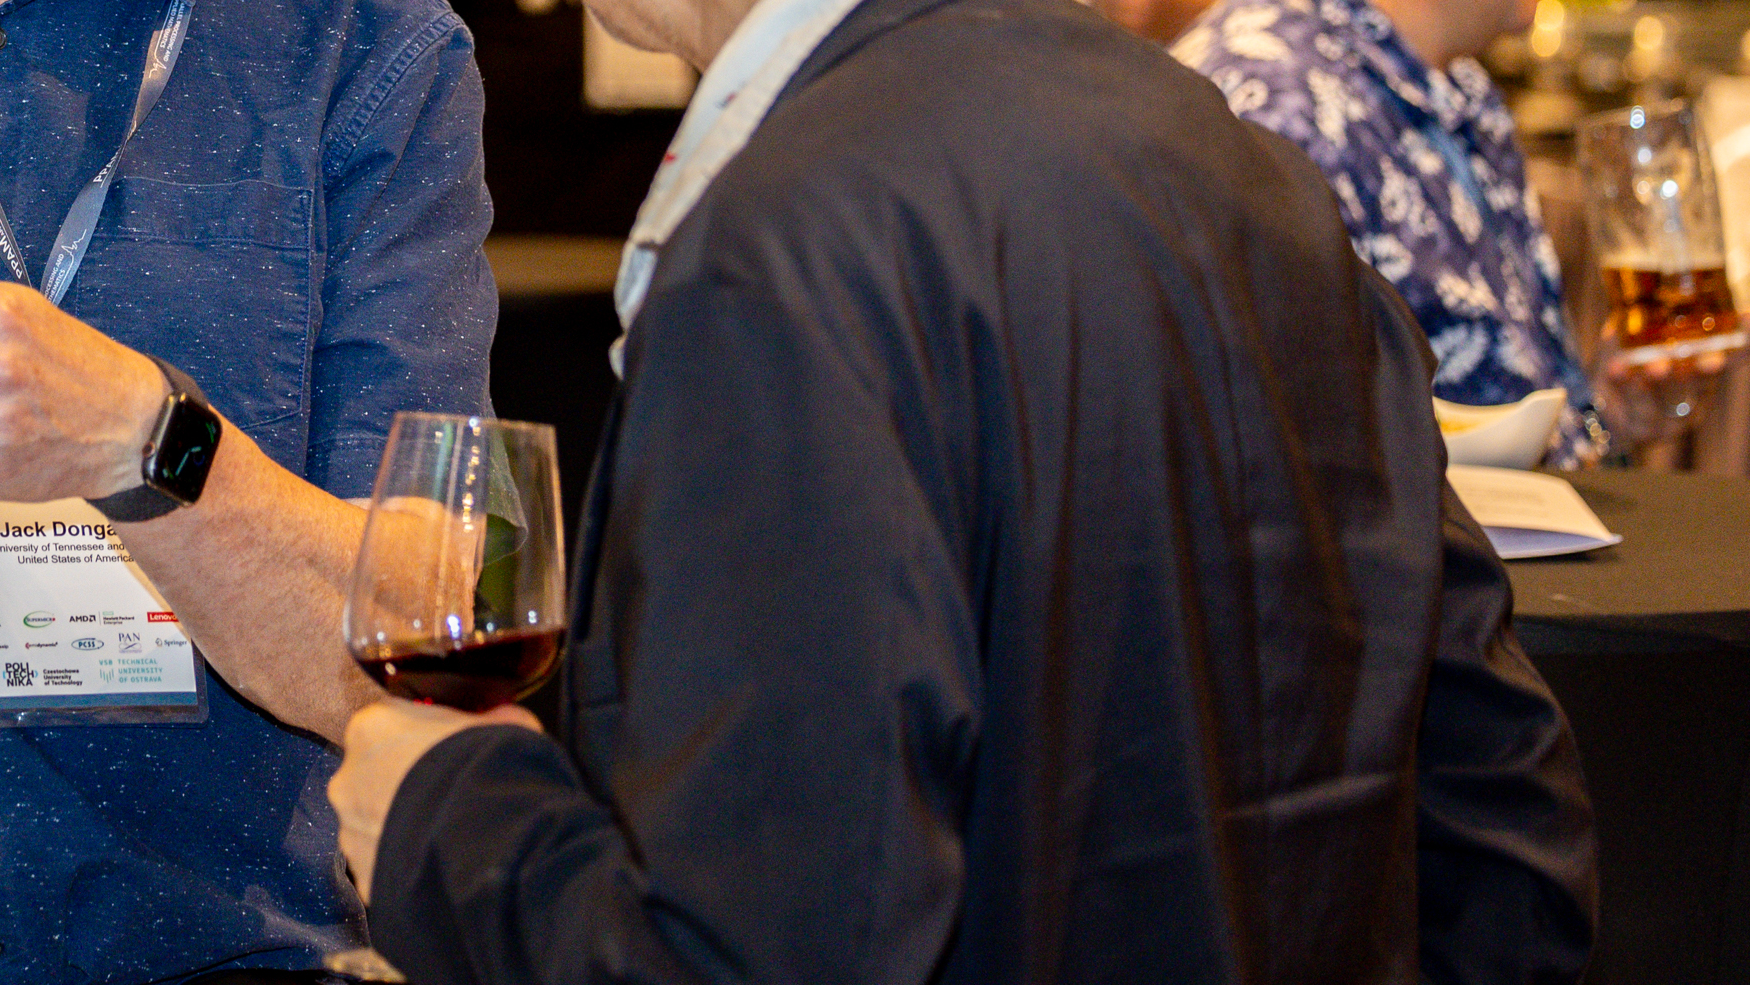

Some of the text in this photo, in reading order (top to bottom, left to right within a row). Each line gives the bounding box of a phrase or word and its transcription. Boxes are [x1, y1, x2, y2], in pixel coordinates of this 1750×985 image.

[170, 0, 179, 16] PPLIED
[176, 2, 185, 20] ALLEL
[163, 50, 171, 62] AND
[0, 235, 23, 279] PPAM
[55, 253, 65, 267] AND
[48, 269, 65, 301] THEMATICS
[0, 521, 117, 540] Jack Donga
[41, 542, 50, 551] of
[52, 542, 104, 551] Tennessee
[18, 554, 135, 564] United States of America
[69, 615, 89, 623] AMD
[118, 632, 141, 642] PAN
[163, 639, 188, 647] Springer
[5, 662, 29, 673] POLI
[6, 669, 35, 679] TECH
[6, 678, 33, 687] NIKA
